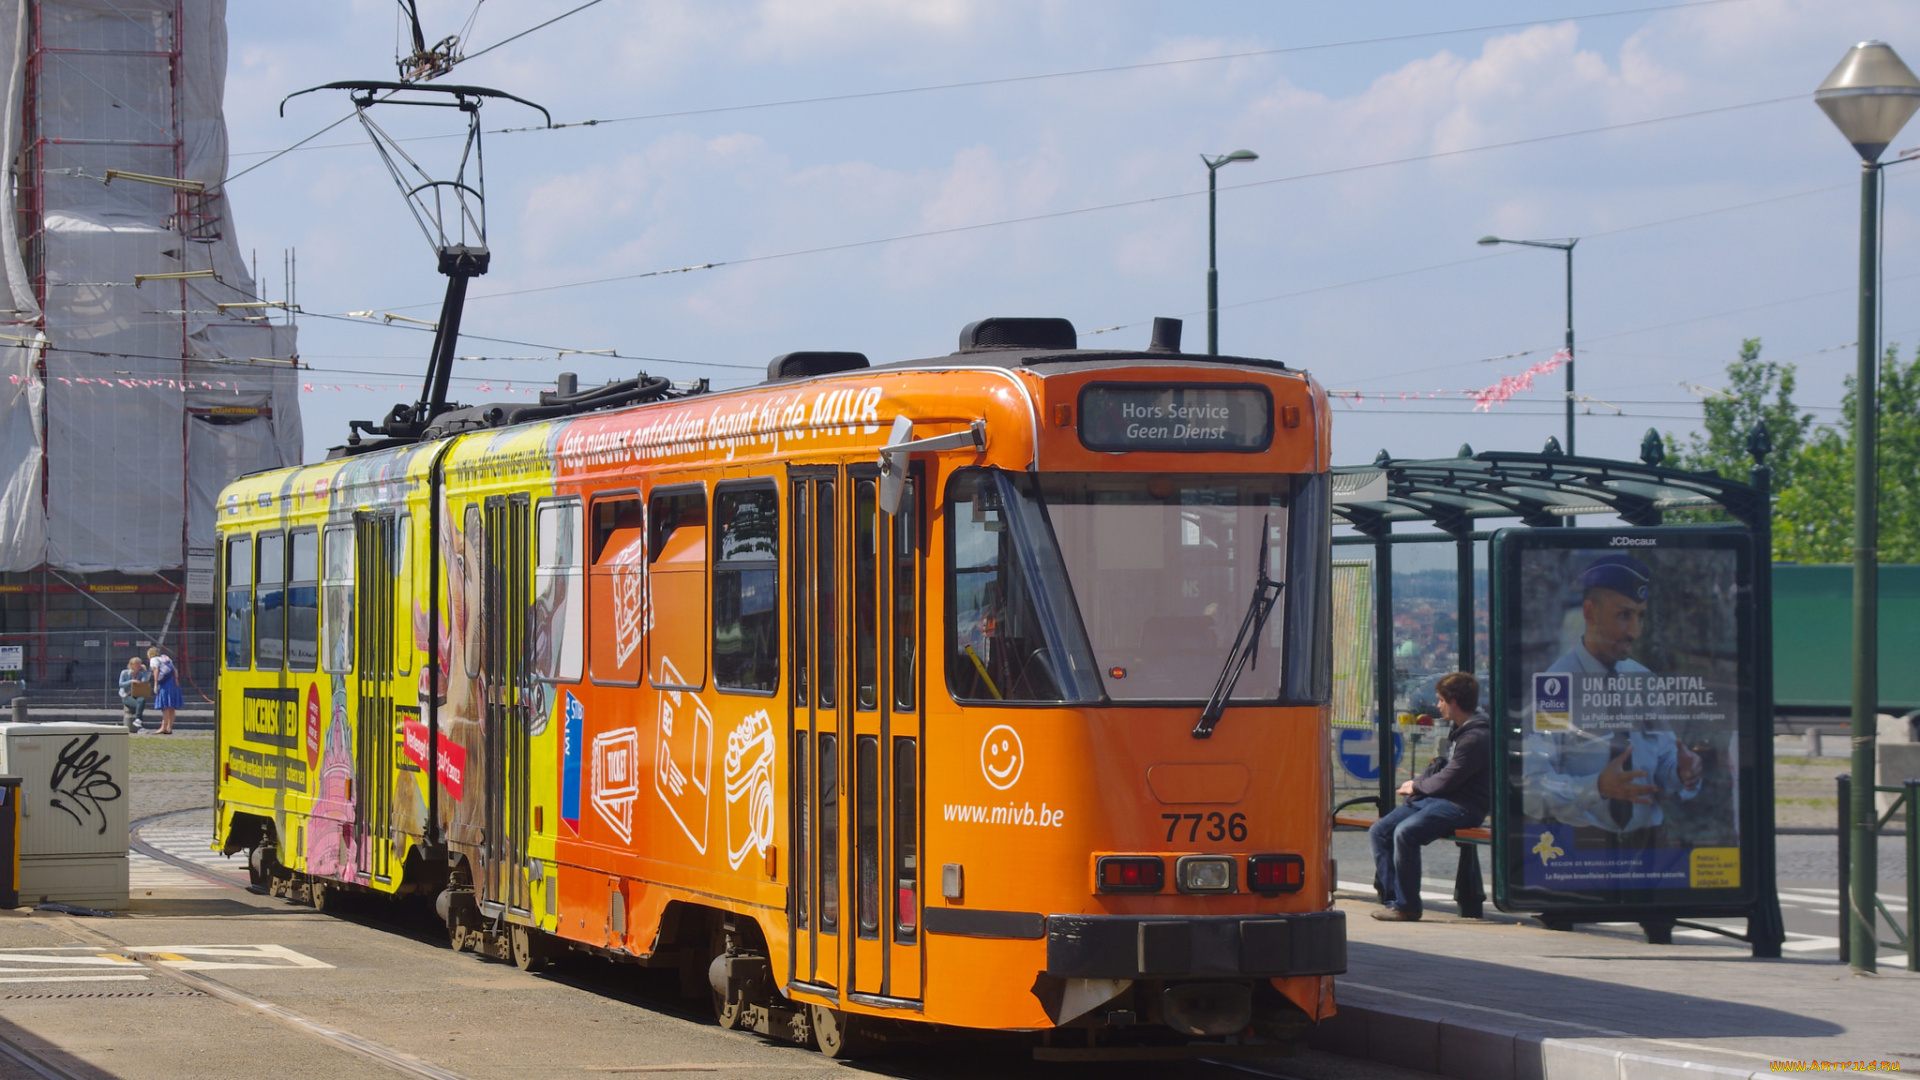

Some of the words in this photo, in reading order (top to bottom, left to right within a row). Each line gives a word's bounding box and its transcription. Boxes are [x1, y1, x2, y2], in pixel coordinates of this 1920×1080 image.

[1122, 403, 1162, 418] Hors
[1168, 403, 1229, 419] Service
[562, 429, 585, 469] Iets
[587, 424, 631, 466] nieuws
[631, 409, 705, 462] ontdekken
[707, 402, 757, 461] begint
[784, 393, 805, 440] de
[809, 386, 883, 438] MIVB
[1126, 424, 1168, 439] Geen
[1173, 424, 1226, 440] Dienst
[1609, 536, 1657, 546] JCDecaux
[1582, 677, 1605, 691] UN
[1608, 674, 1642, 691] RÔLE
[1646, 676, 1706, 691] CAPITAL
[1540, 700, 1566, 708] Police
[1582, 693, 1621, 707] POUR
[1625, 693, 1643, 707] LA
[1646, 692, 1718, 707] CAPITALE.
[1591, 713, 1614, 721] Police
[943, 802, 1064, 828] www.mivb.be
[1161, 812, 1248, 842] 7736
